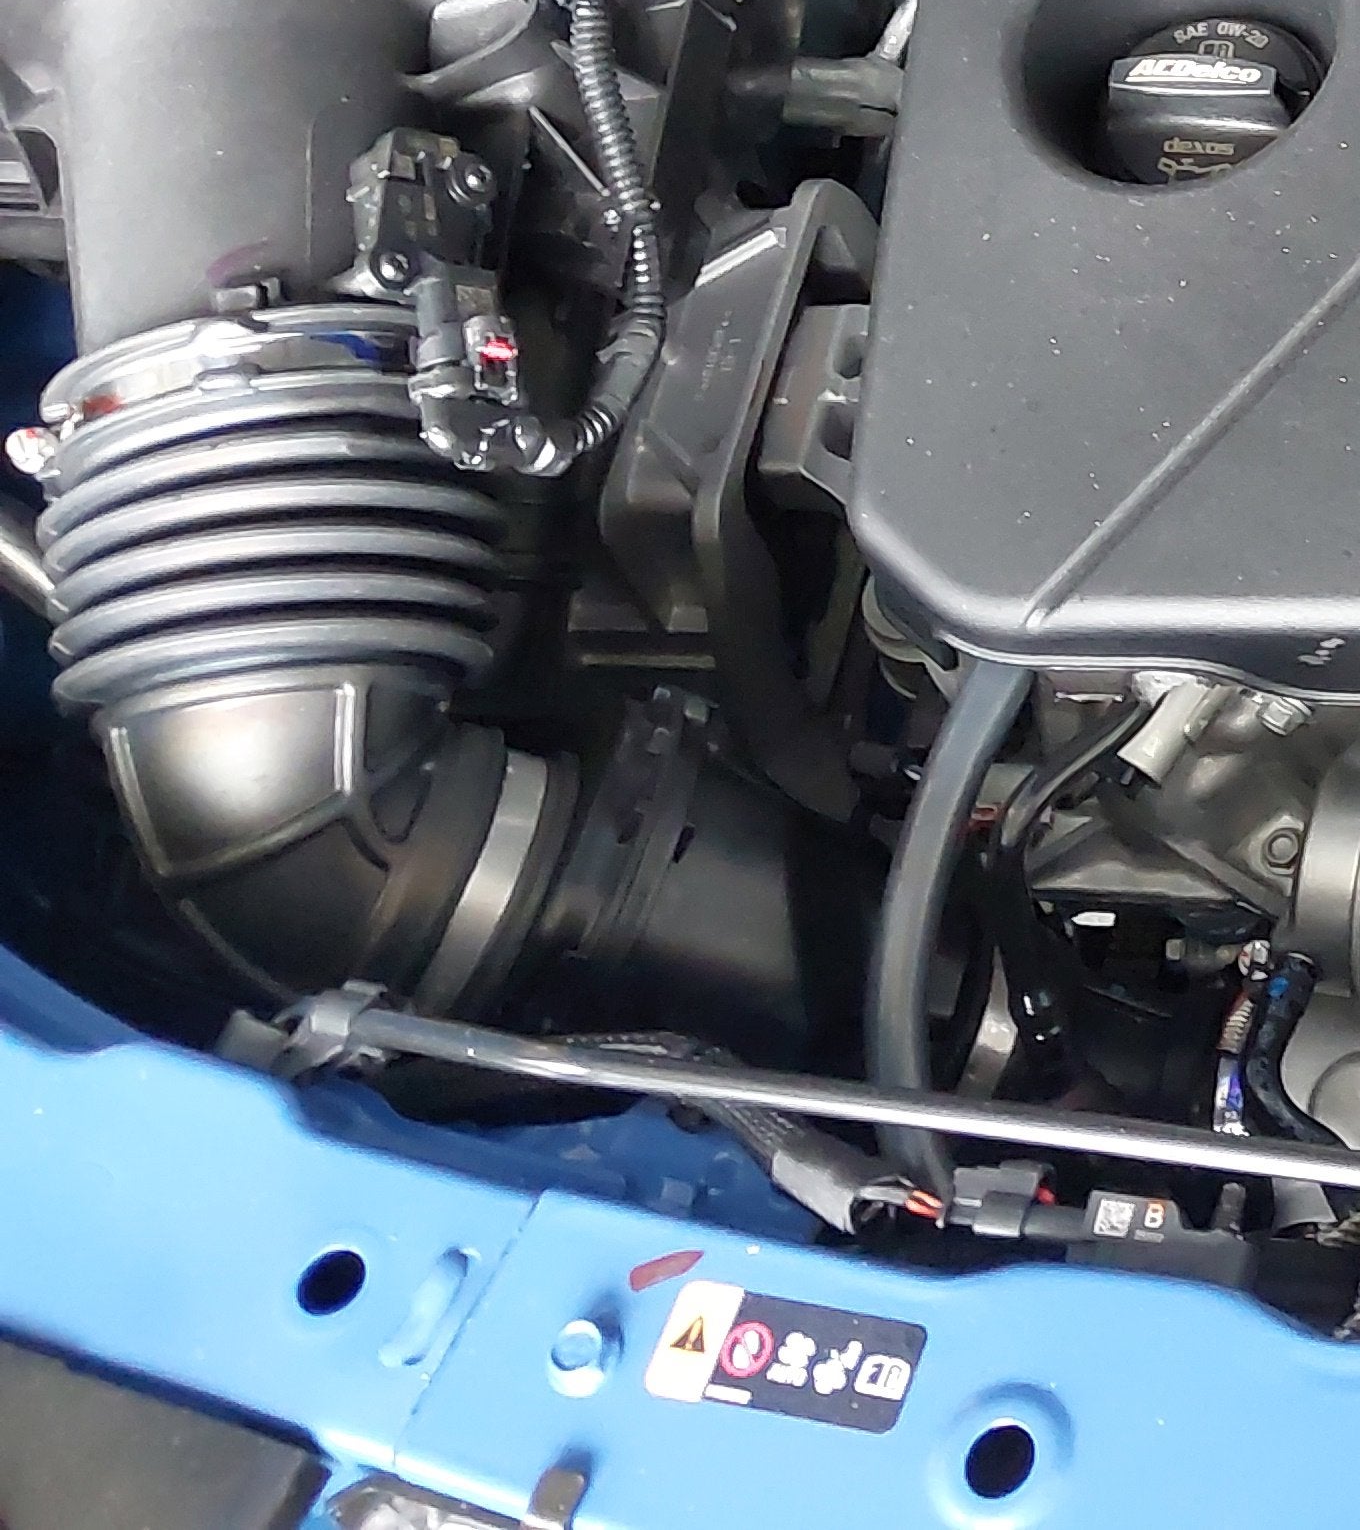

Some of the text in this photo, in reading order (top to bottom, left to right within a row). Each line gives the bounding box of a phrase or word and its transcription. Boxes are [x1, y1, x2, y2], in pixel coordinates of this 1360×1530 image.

[1173, 21, 1270, 49] SAE 0W-20
[1129, 59, 1262, 82] ACDelco
[1143, 1202, 1165, 1229] B
